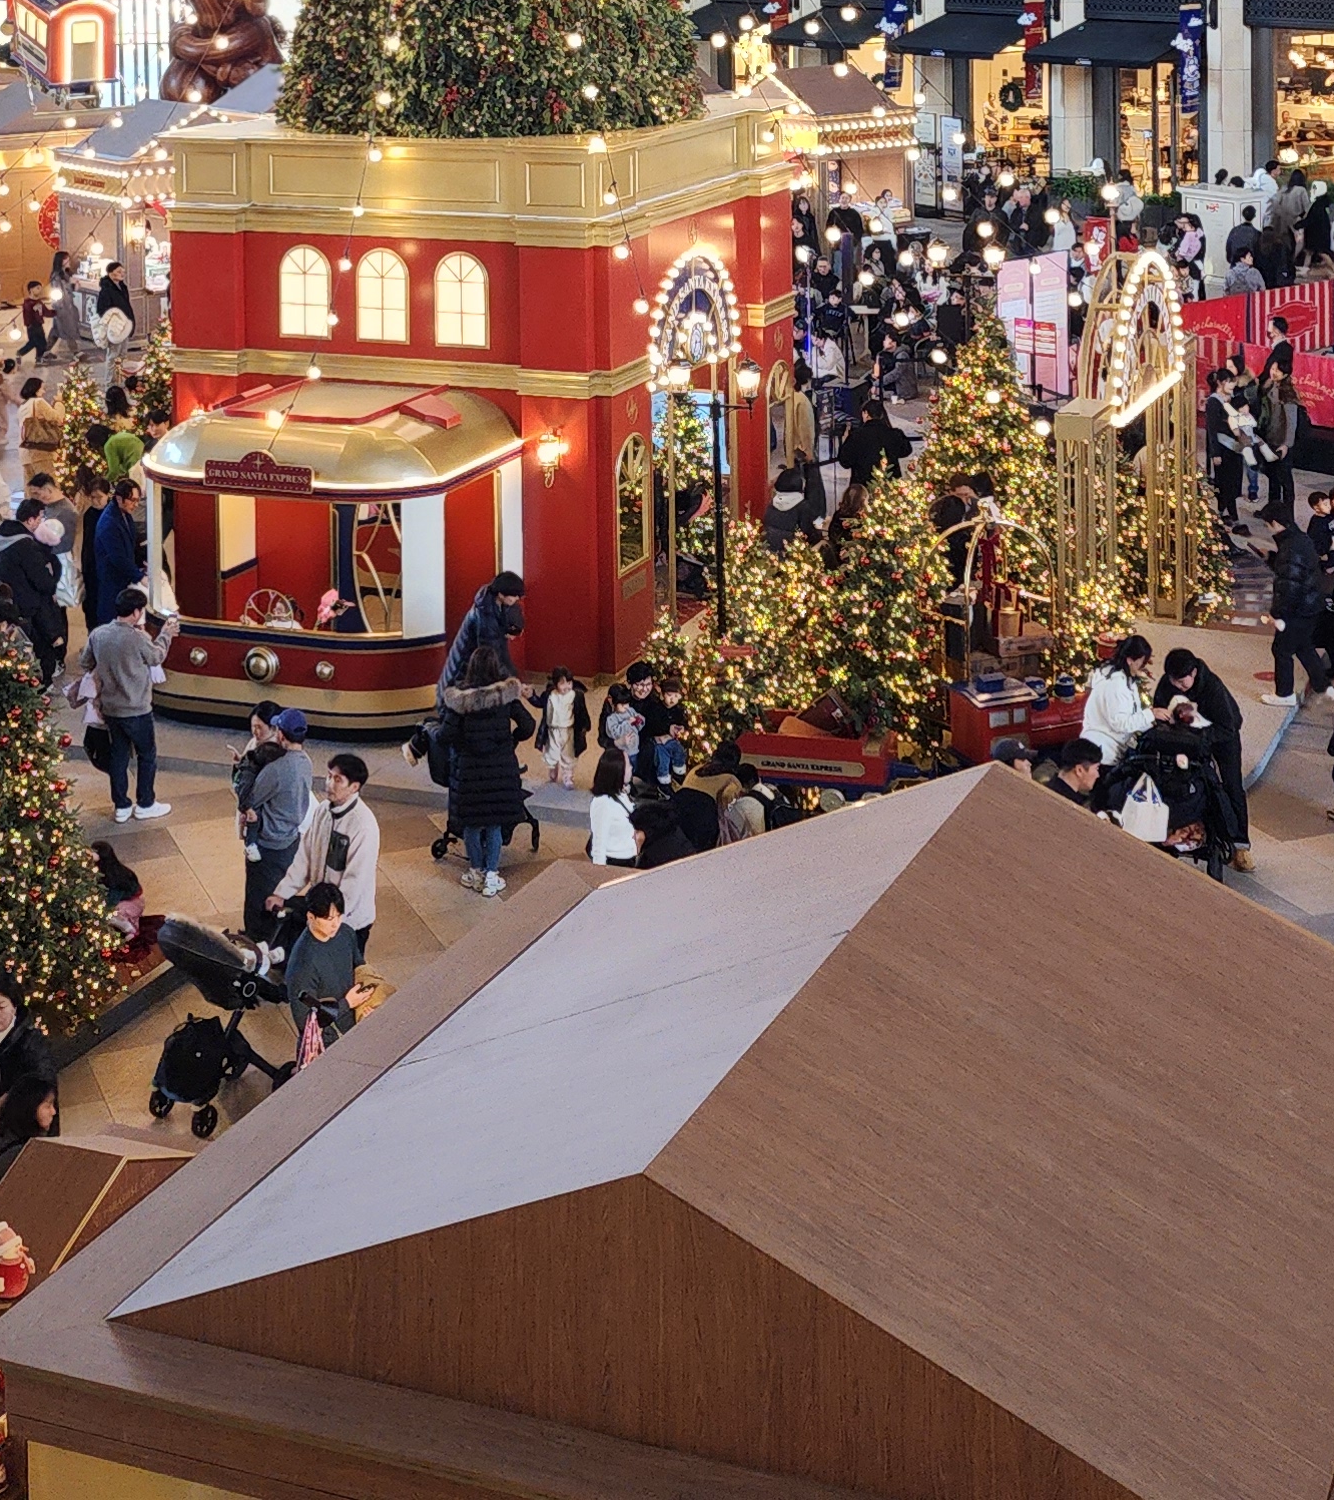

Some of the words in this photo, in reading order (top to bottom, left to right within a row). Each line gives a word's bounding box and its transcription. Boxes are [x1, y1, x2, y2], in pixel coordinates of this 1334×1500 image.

[208, 468, 239, 479] GRAND
[240, 471, 268, 481] SANTA
[269, 474, 308, 484] EXPRESS
[787, 762, 810, 770] SANTA
[810, 764, 843, 773] EXPRESS
